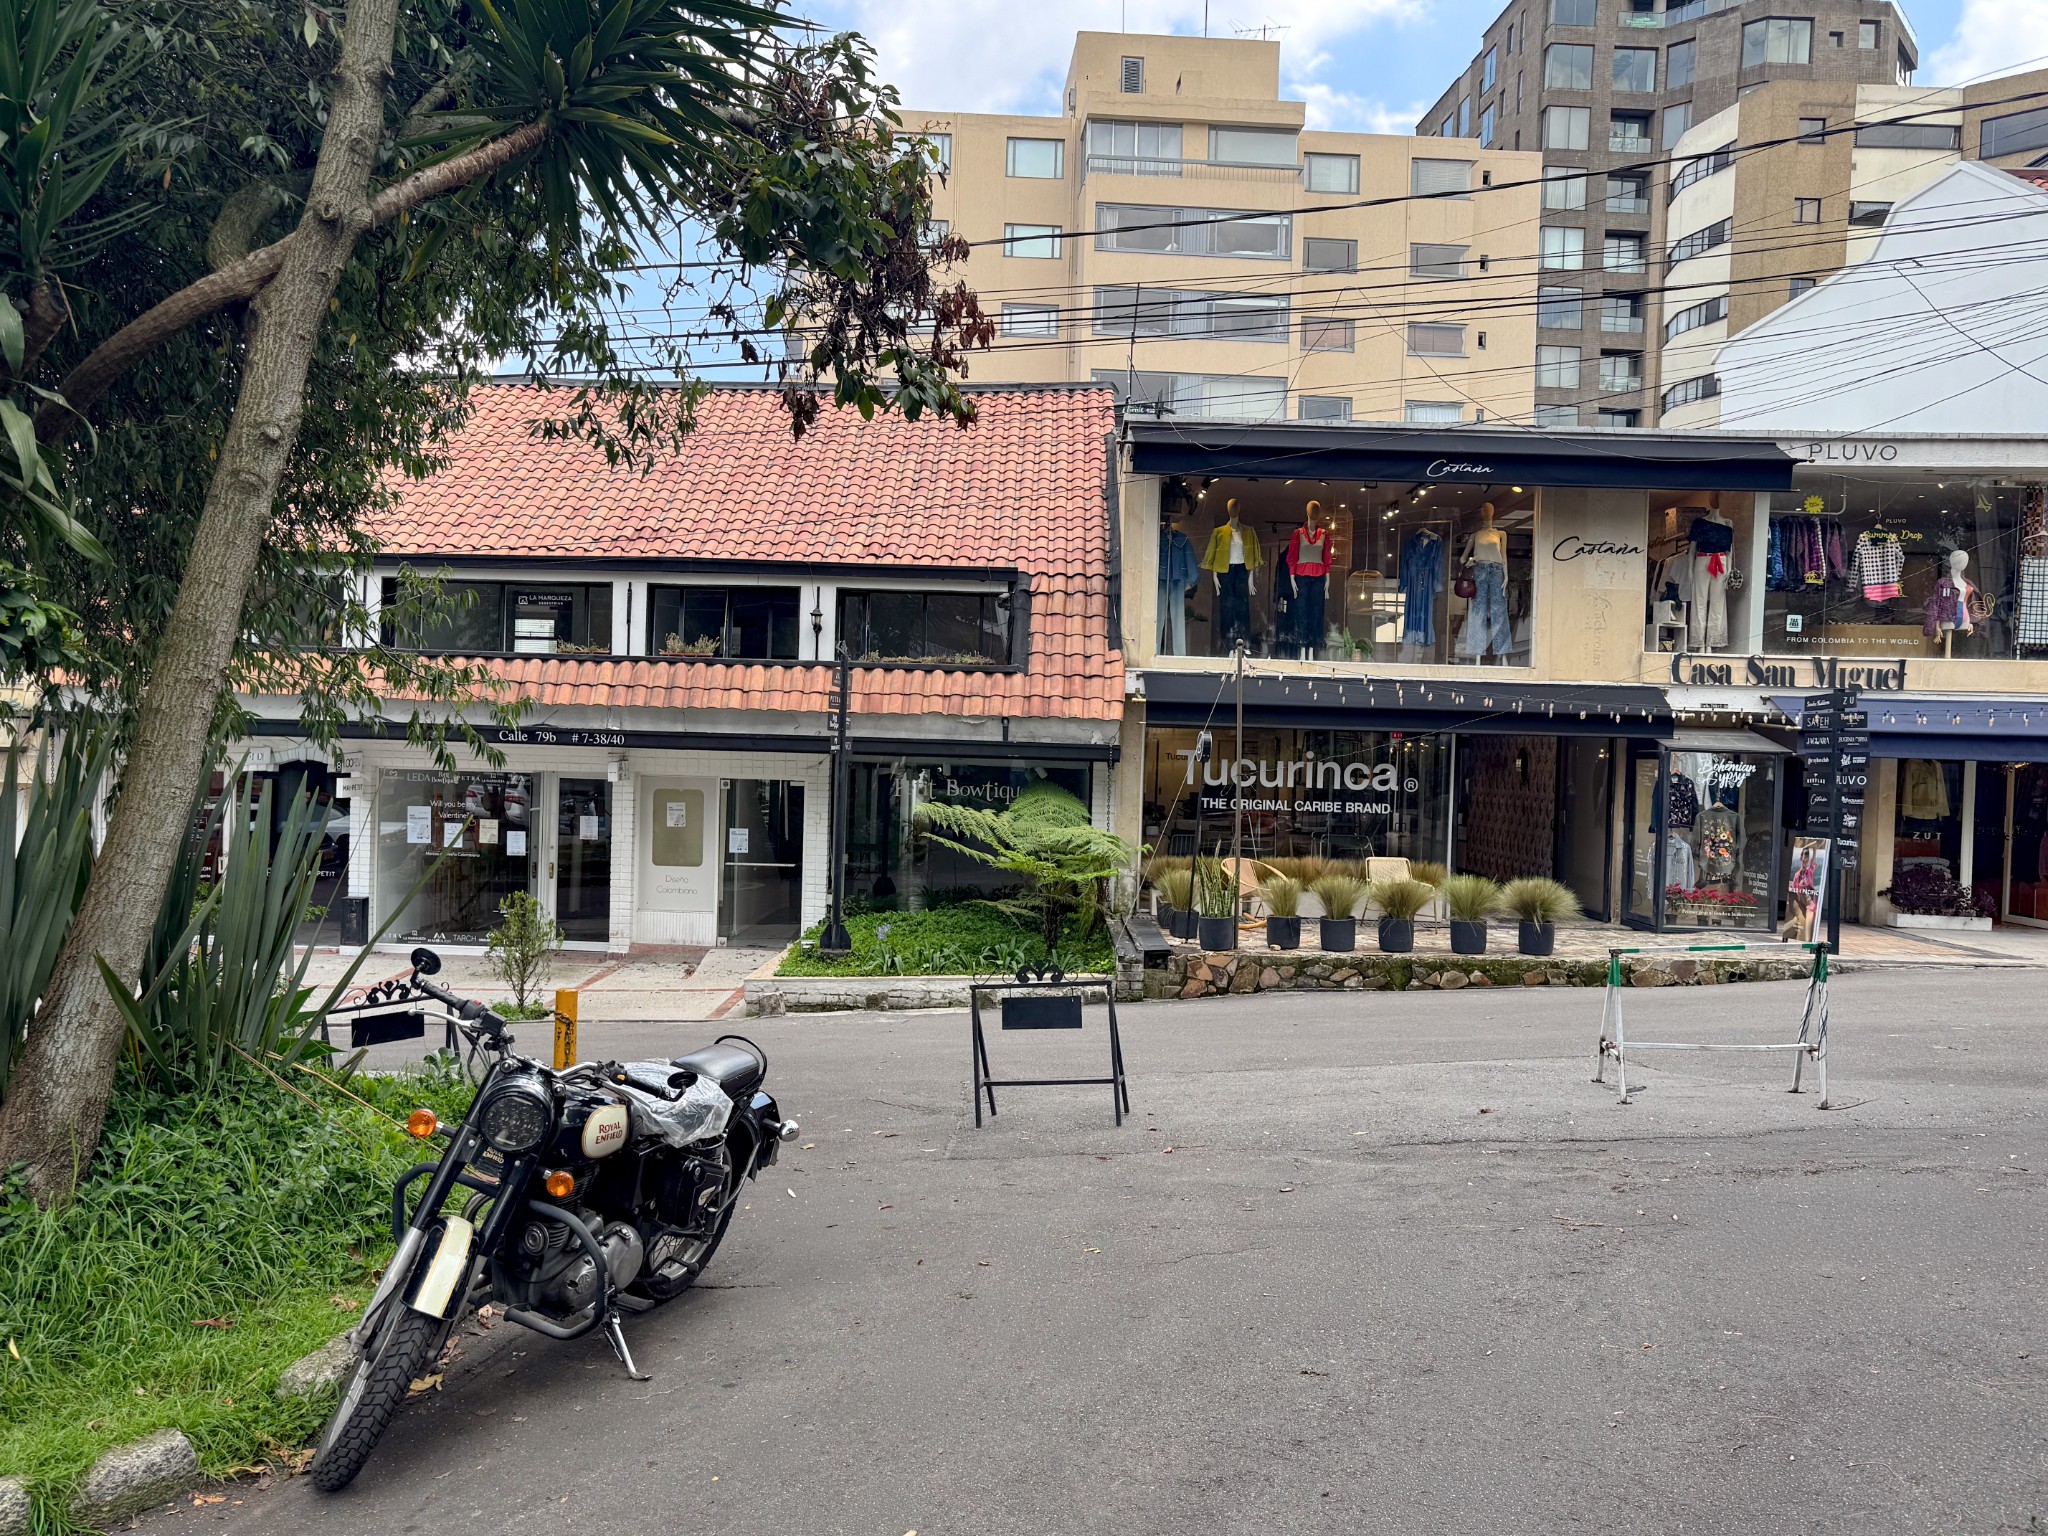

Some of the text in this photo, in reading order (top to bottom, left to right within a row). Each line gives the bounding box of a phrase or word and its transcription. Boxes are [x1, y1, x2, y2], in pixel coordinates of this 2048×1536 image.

[1809, 444, 1898, 461] PLUVO
[1900, 529, 1923, 541] Drop
[1672, 653, 1732, 686] Casa
[1746, 655, 1796, 687] San
[499, 730, 529, 742] Calle
[535, 731, 557, 743] 79b
[581, 733, 625, 745] 7-38/40
[1176, 749, 1399, 792] Tucurinca
[1697, 758, 1757, 774] Bohemian
[406, 772, 431, 782] LEDA
[1696, 770, 1747, 788] Gypsy
[946, 778, 1021, 805] Bowtiqu
[430, 799, 442, 807] Will
[444, 801, 456, 809] you
[467, 802, 477, 810] my
[1201, 798, 1391, 814] THE ORIGINAL CARIBE BRAND
[438, 811, 470, 819] Valentine?
[656, 885, 698, 895] Colombiano
[453, 933, 477, 942] TARCH
[598, 1121, 621, 1134] ROYAL
[595, 1129, 624, 1145] ENFIELD
